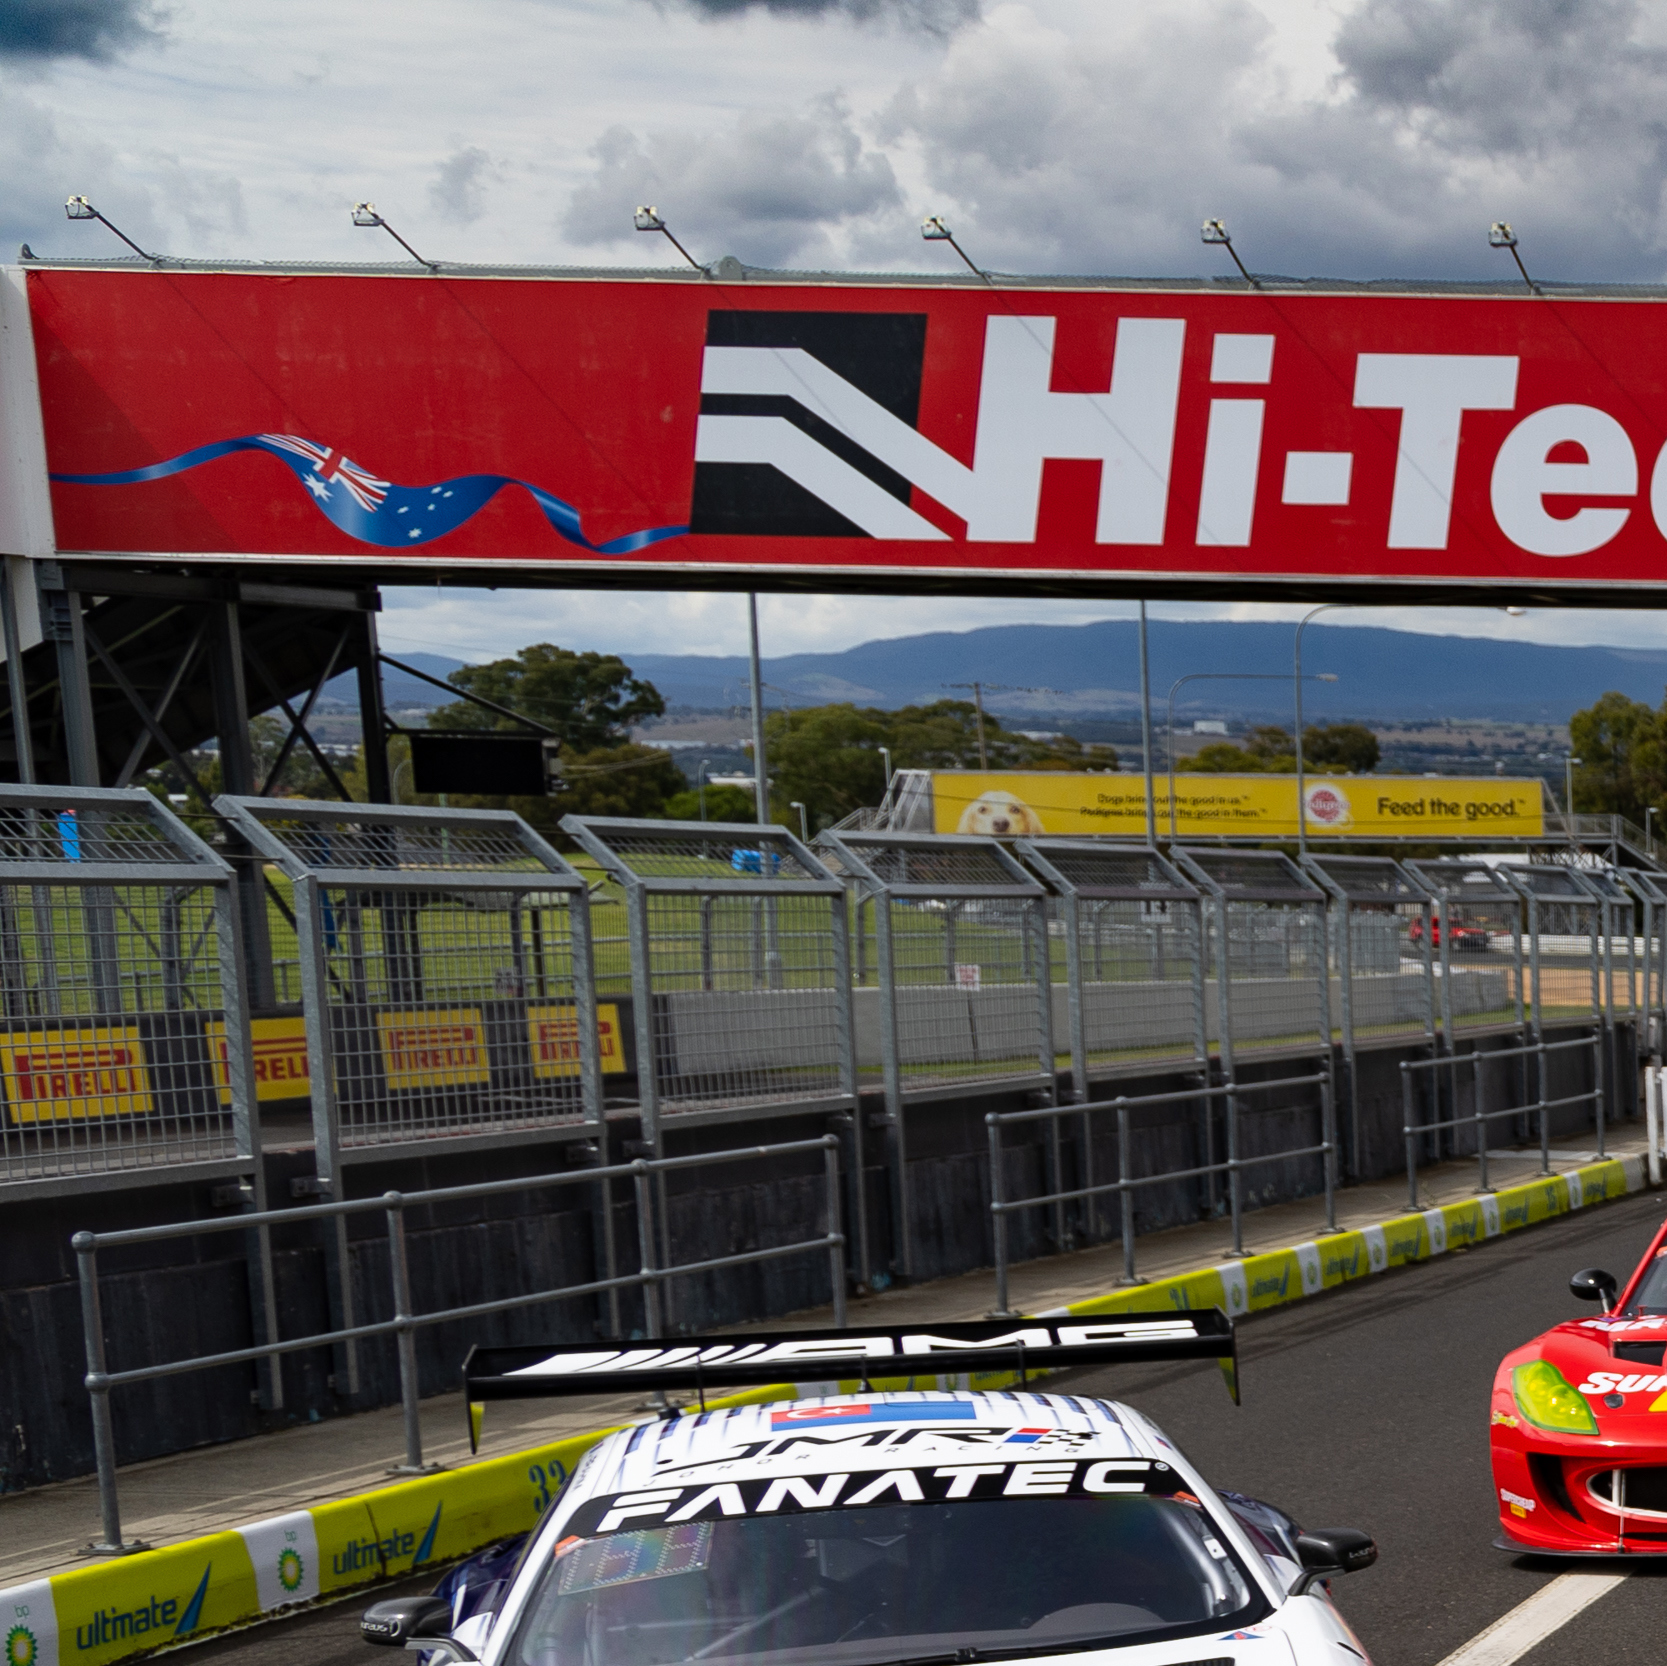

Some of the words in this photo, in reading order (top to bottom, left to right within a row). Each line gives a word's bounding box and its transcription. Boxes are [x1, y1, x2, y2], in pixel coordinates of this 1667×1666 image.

[1377, 796, 1425, 816] Feed
[1429, 796, 1460, 815] the
[387, 1026, 476, 1070] PIRELLI
[15, 1049, 136, 1101] PIRELLI
[643, 1453, 809, 1488] JOHOR
[886, 1442, 1080, 1455] RACING
[596, 1460, 1152, 1534] FANATEC
[333, 1530, 416, 1577] ultimate
[76, 1594, 178, 1651] ultimate
